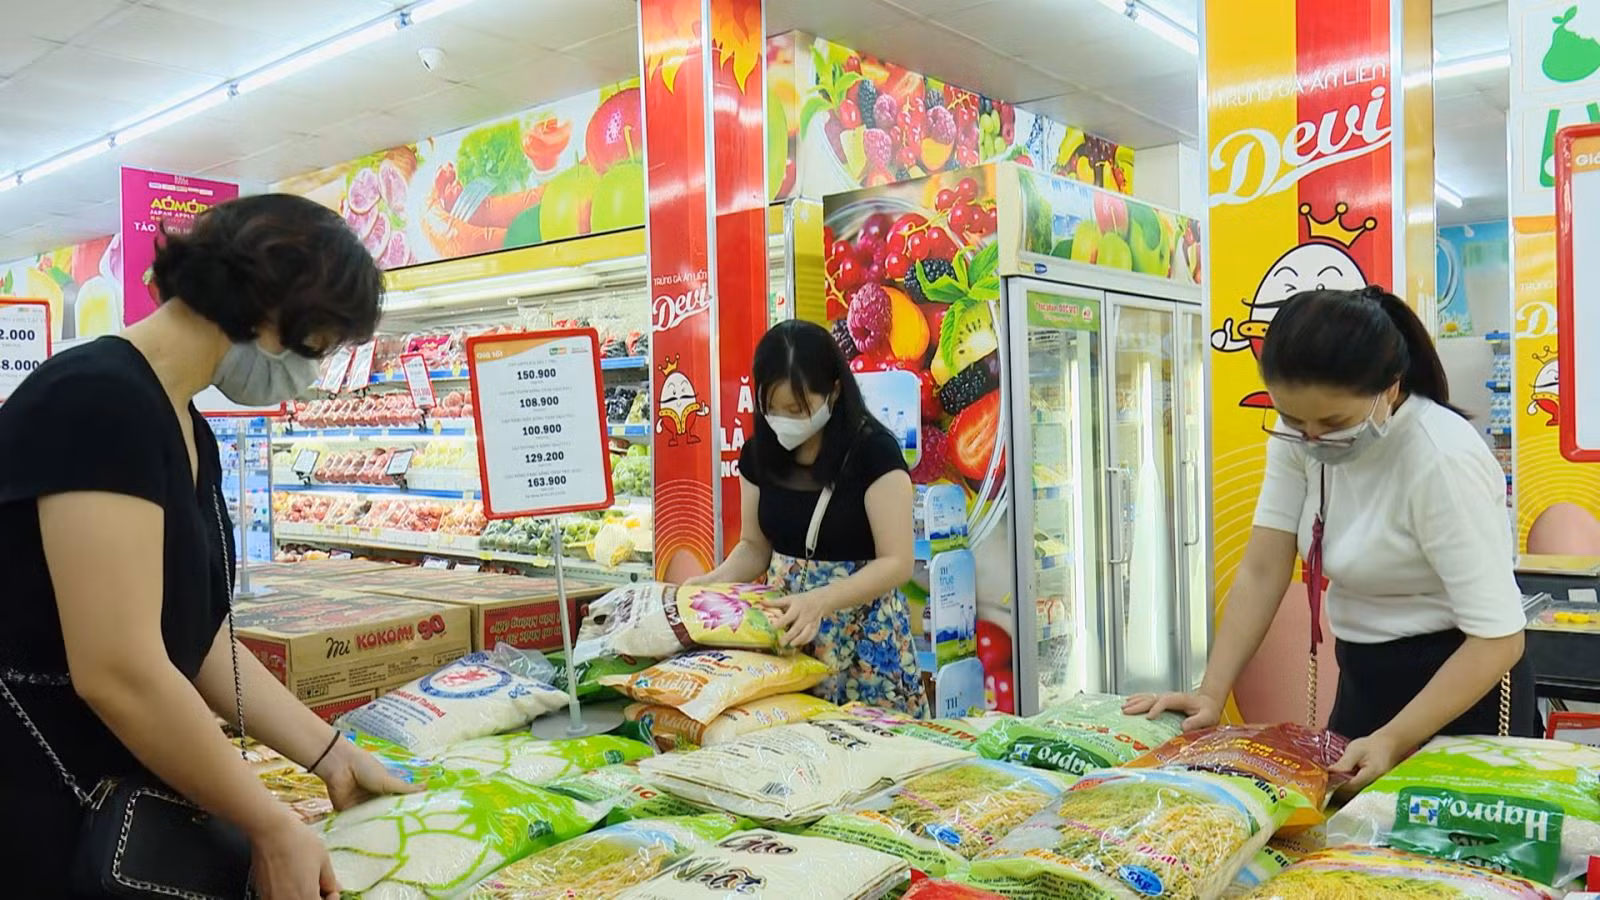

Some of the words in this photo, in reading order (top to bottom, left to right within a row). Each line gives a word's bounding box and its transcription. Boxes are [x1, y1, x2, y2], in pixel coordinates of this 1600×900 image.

[1208, 86, 1392, 208] Devi
[652, 282, 711, 331] Devi
[517, 368, 557, 380] 150.900
[520, 396, 559, 408] 108.900
[522, 424, 562, 436] 100.900
[525, 451, 564, 463] 129.200
[528, 475, 567, 488] 163.900
[355, 624, 416, 652] KOKOMI
[417, 613, 446, 641] 90
[1037, 746, 1094, 776] apro
[1449, 799, 1549, 841] Hapro
[1126, 871, 1154, 891] 5kg
